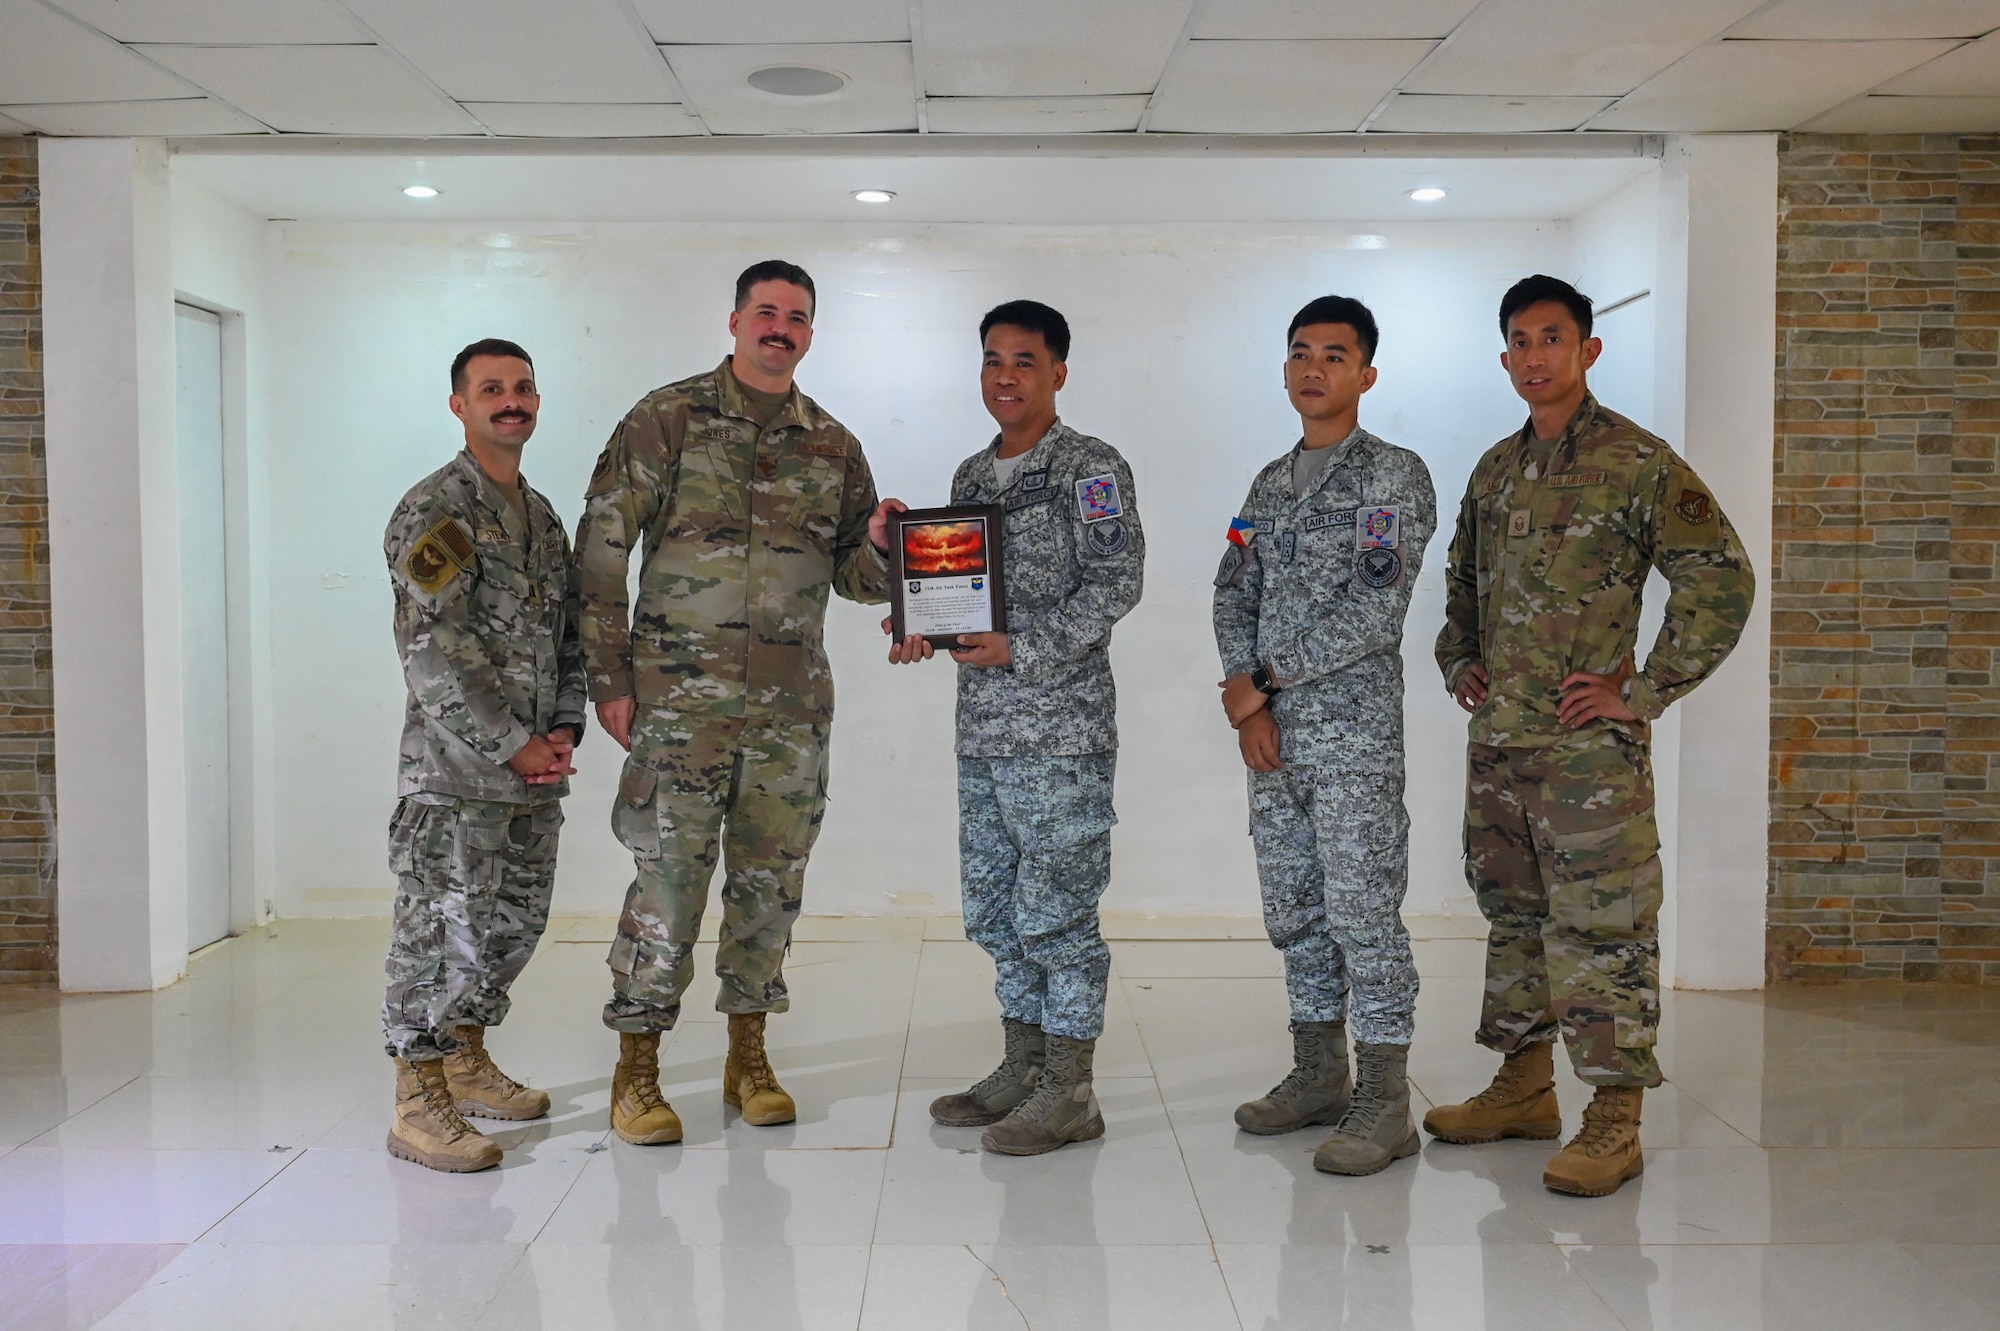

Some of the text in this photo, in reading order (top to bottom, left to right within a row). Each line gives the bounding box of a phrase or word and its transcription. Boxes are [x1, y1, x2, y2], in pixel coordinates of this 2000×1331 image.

[702, 427, 730, 439] JONES
[1564, 475, 1578, 485] AIR
[1578, 473, 1602, 484] FORCE
[1007, 488, 1057, 509] AIR FORCE
[1307, 517, 1326, 528] AIR
[1327, 511, 1358, 524] FORC
